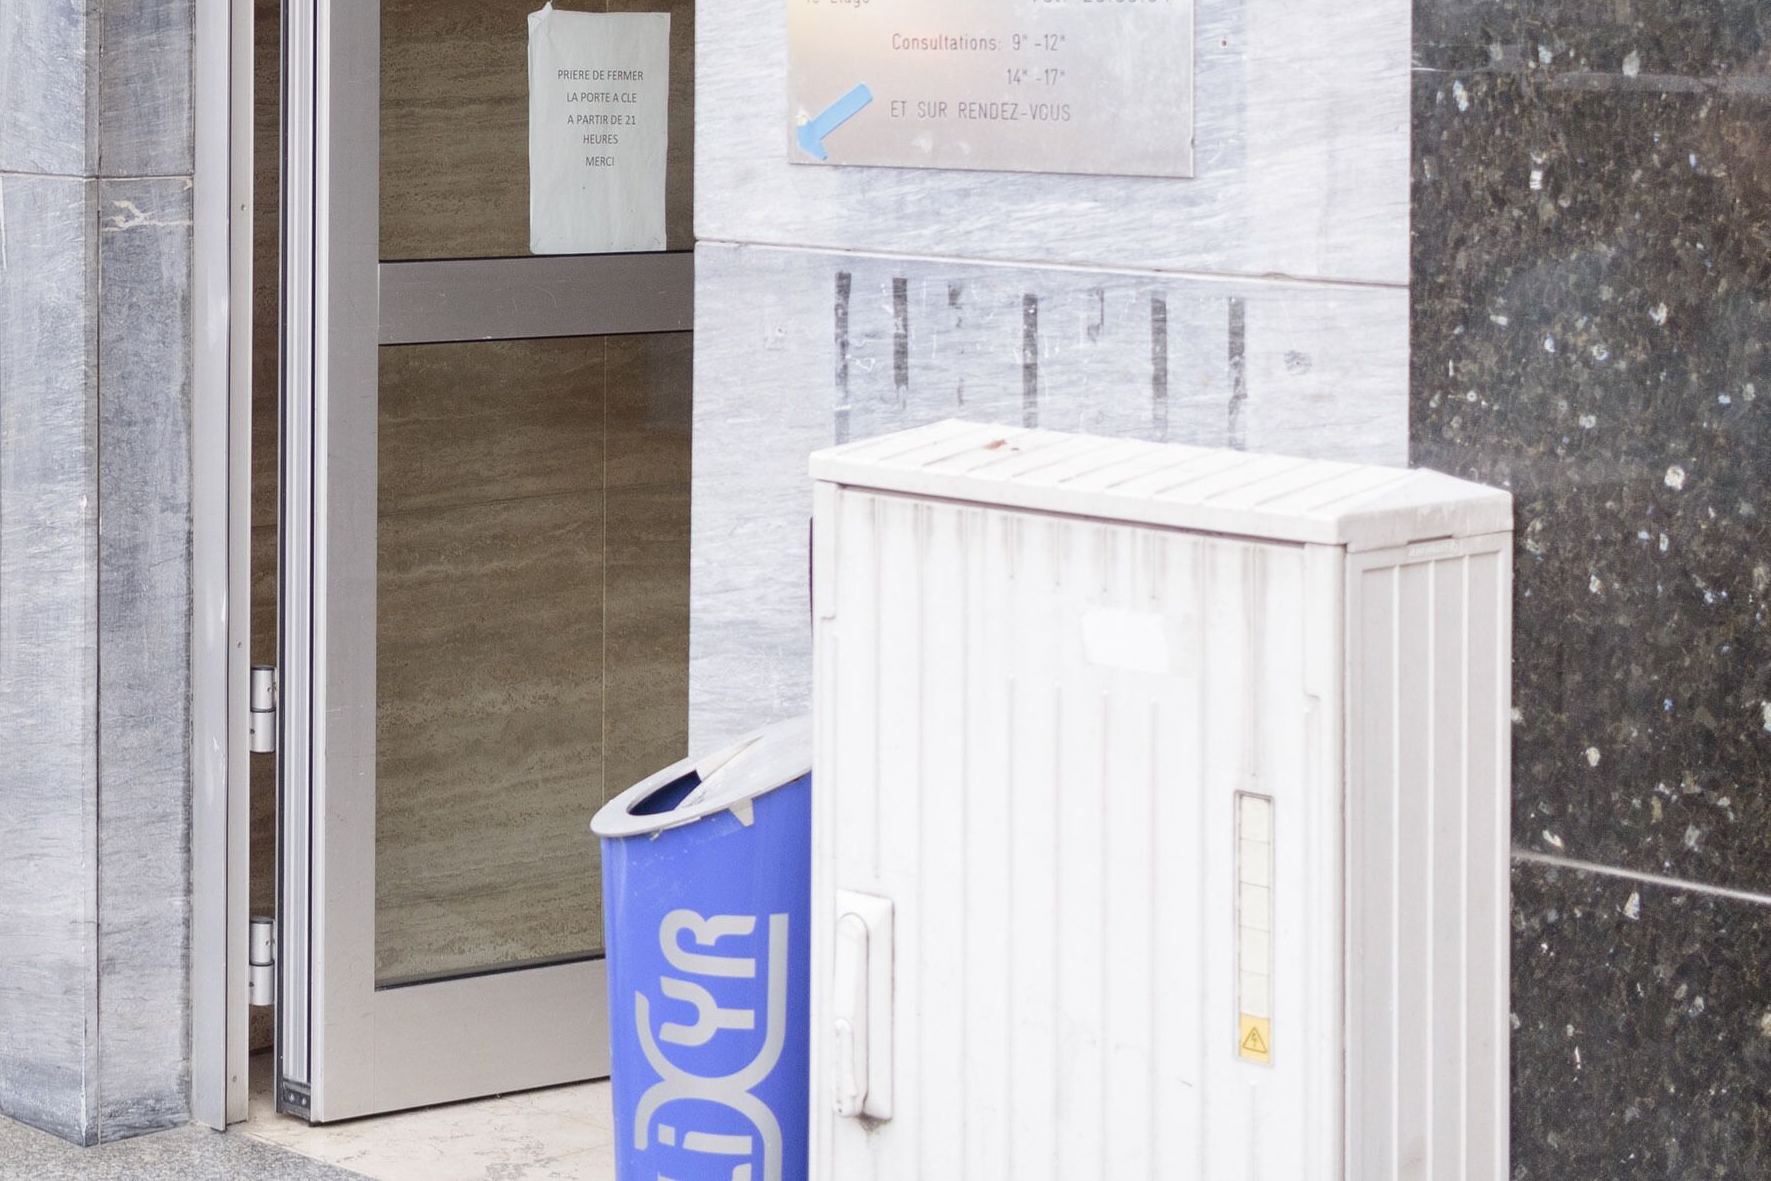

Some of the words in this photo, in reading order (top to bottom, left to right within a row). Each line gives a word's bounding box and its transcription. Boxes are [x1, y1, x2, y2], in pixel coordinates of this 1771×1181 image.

[557, 69, 591, 81] PRIERE
[592, 69, 605, 81] DE
[607, 69, 644, 81] FERMER
[566, 92, 579, 103] LA
[580, 92, 611, 104] PORTE
[612, 92, 620, 103] A
[621, 92, 637, 104] CLE
[890, 100, 908, 118] ET
[916, 100, 948, 119] SUR
[958, 101, 1072, 122] RENDEZ-VOUS
[567, 115, 575, 125] A
[577, 114, 609, 125] PARTIR
[611, 114, 623, 125] DE
[625, 114, 636, 125] 21
[583, 134, 619, 145] HEURES
[585, 156, 615, 167] MERCI
